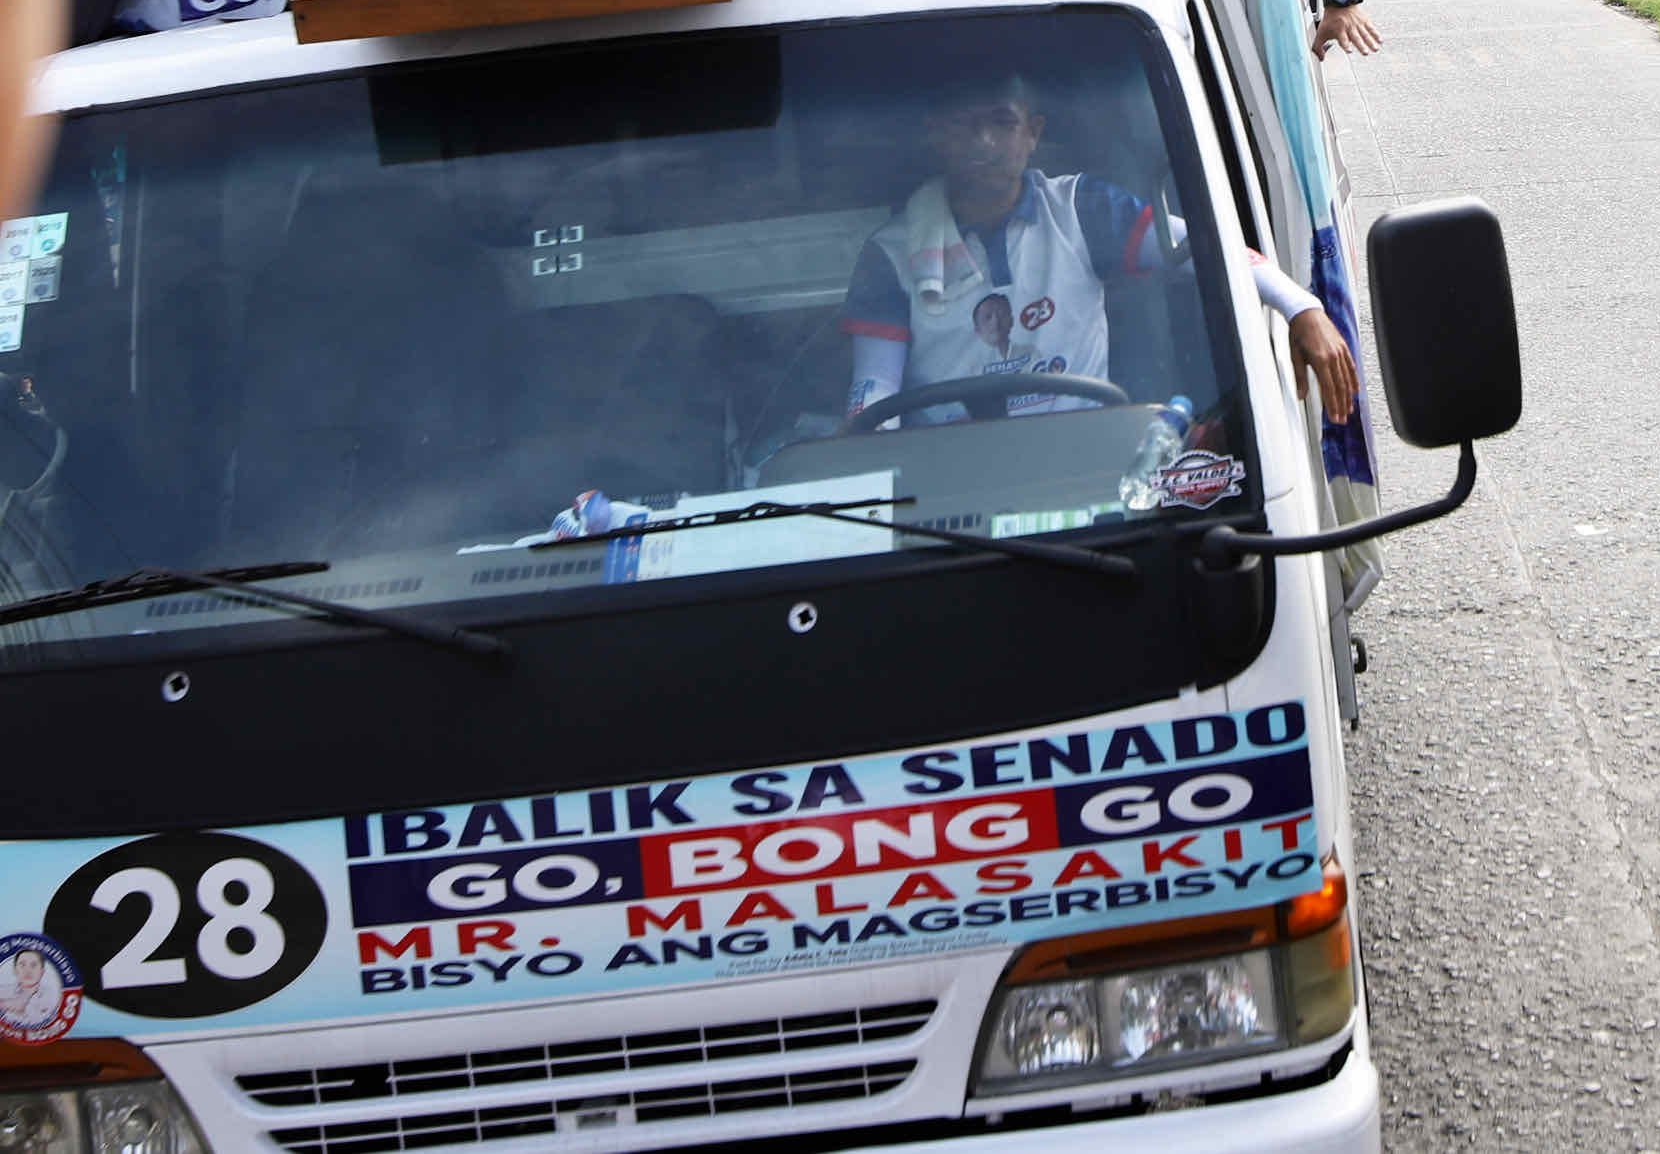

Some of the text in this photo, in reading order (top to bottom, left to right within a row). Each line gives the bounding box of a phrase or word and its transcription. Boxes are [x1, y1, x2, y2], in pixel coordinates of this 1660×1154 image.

[730, 763, 865, 816] SA
[901, 700, 1306, 795] SENADO
[357, 813, 1313, 965] MR. MALASAKIT
[427, 773, 1253, 910] GO, BONG GO
[90, 858, 286, 990] 28
[361, 951, 584, 995] BISYO
[604, 928, 770, 971] ANG
[793, 852, 1315, 949] MAGSERBISYO
